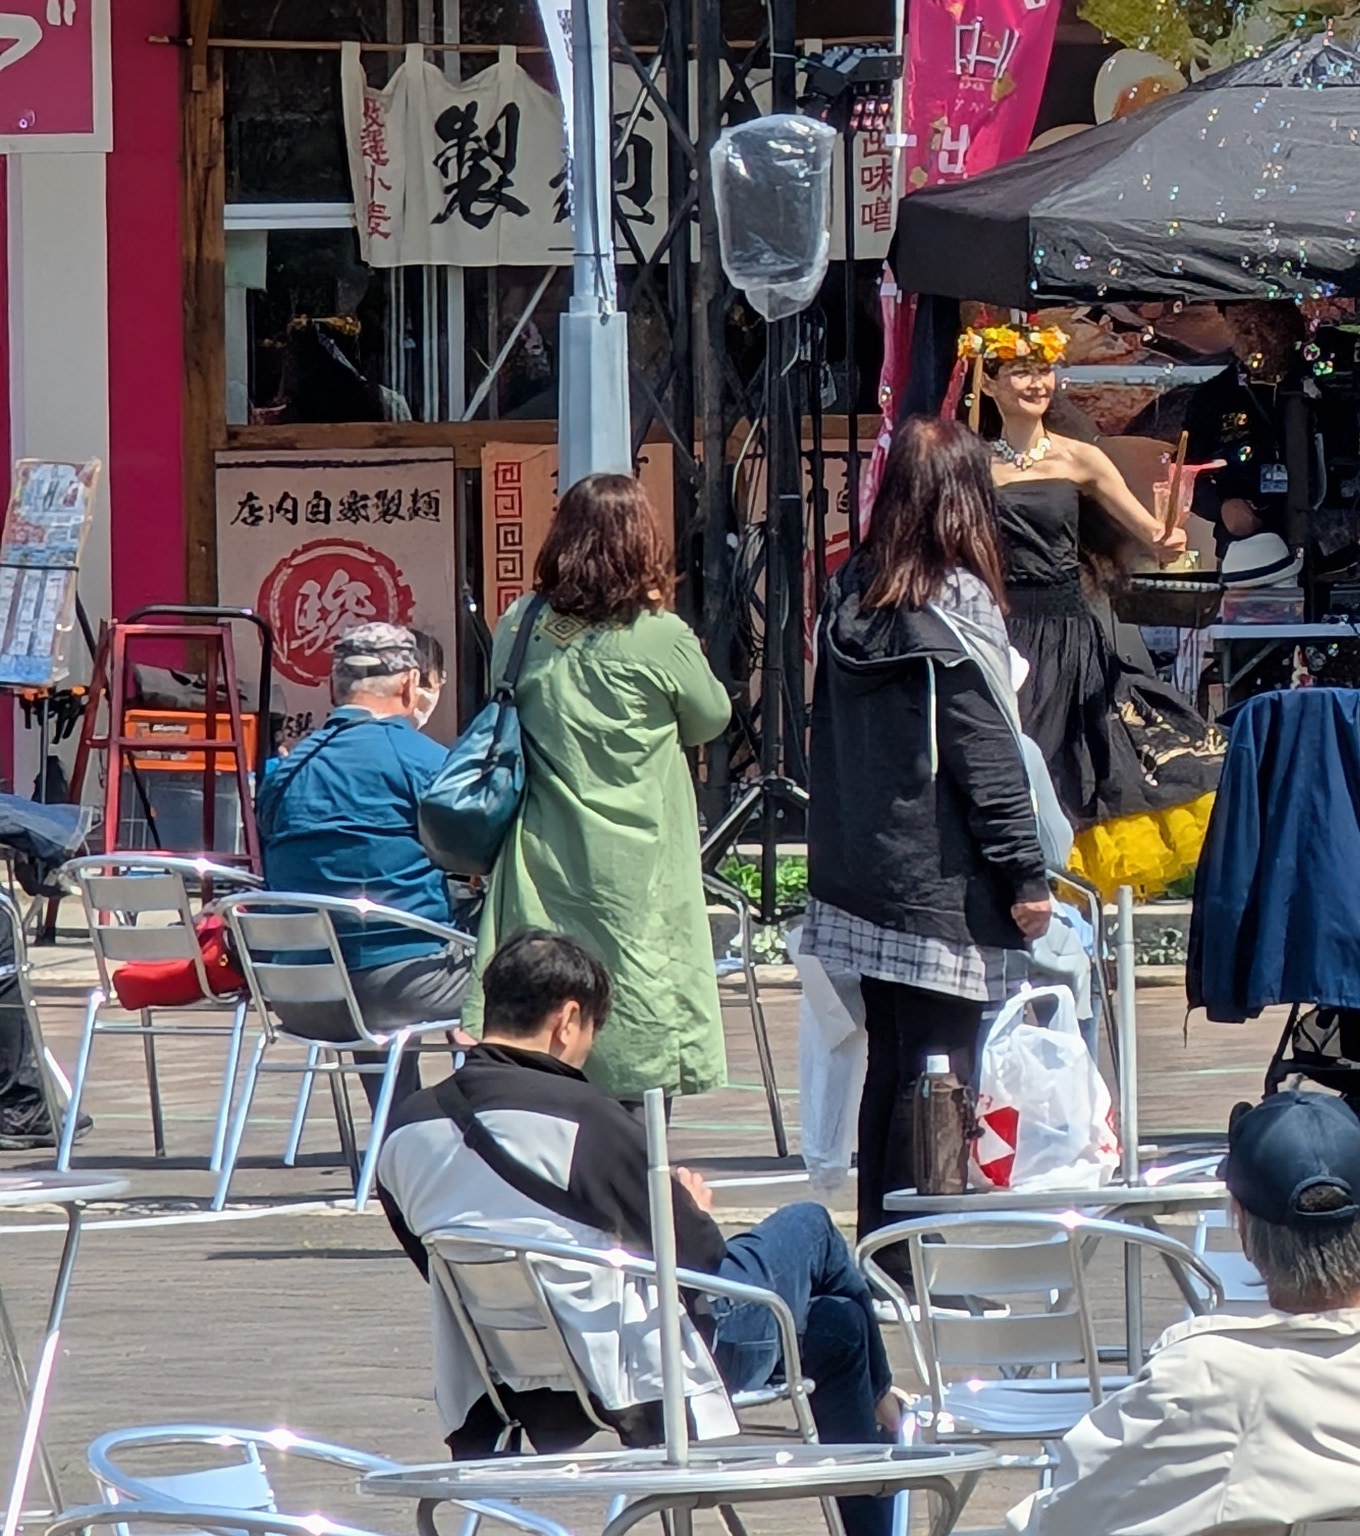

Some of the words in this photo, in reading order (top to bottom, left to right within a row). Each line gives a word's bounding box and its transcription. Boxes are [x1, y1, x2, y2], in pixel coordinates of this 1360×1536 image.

[861, 128, 893, 233] 出味噌
[230, 488, 442, 527] 店内自家製麺
